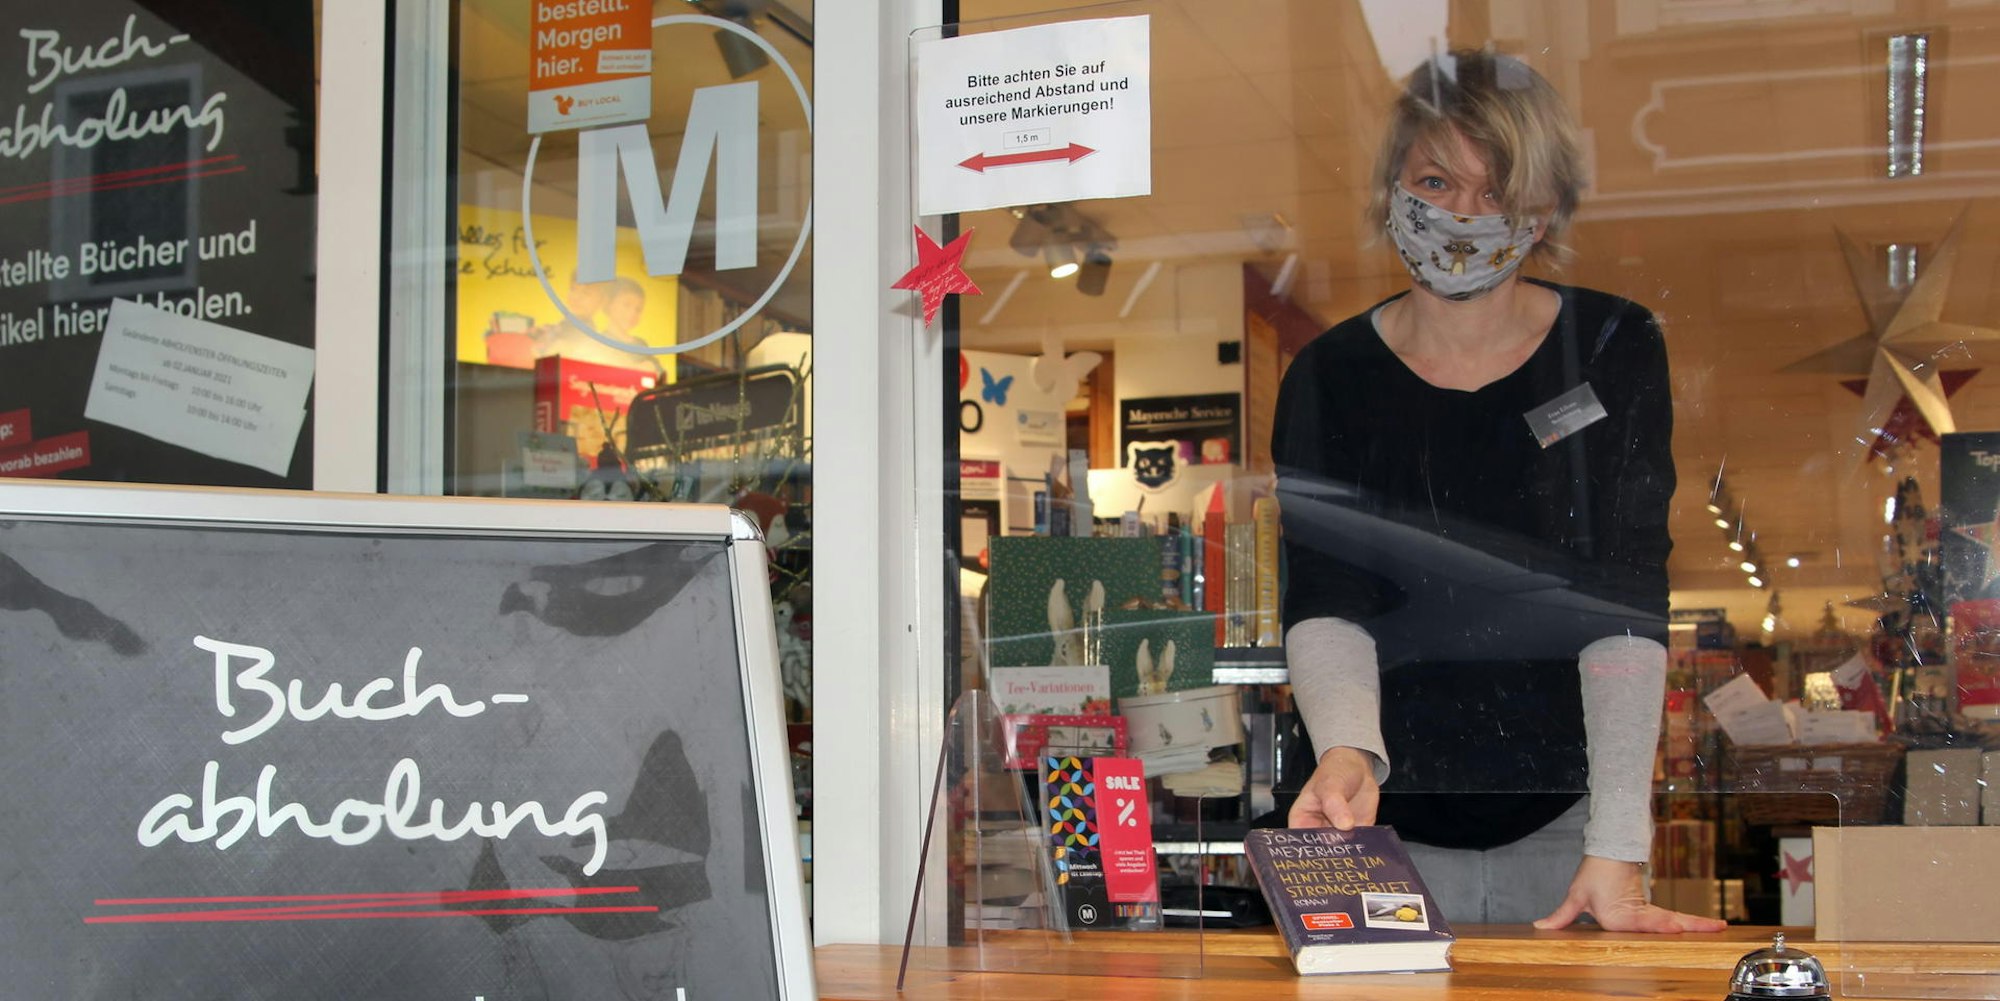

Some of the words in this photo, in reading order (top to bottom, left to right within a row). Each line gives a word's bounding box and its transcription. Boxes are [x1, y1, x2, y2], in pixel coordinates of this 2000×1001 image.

[538, 24, 622, 50] Morgen
[20, 14, 190, 94] Buch-
[537, 56, 583, 78] hier.
[967, 73, 1000, 88] Bitte
[1004, 68, 1051, 84] achten
[1055, 64, 1077, 77] Sie
[1081, 60, 1106, 74] auf
[578, 99, 593, 107] BUY
[595, 96, 622, 105] LOCAL
[945, 87, 1031, 108] ausreichend
[1035, 80, 1095, 98] Abstand
[1100, 77, 1129, 91] und
[959, 110, 1007, 126] unsere
[1011, 97, 1114, 120] Markierungen!
[1016, 133, 1029, 144] 1,5
[1030, 134, 1039, 142] m
[577, 80, 759, 284] M
[0, 249, 69, 288] tellte
[80, 235, 189, 275] Bücher
[199, 219, 257, 260] und
[0, 307, 44, 348] ikel
[54, 301, 108, 338] hier
[1128, 407, 1188, 425] Mayersche
[1190, 405, 1233, 419] Service
[33, 446, 83, 467] bezahlen
[193, 634, 530, 745] Buch-
[1005, 681, 1095, 695] Tee-Variationen
[1105, 775, 1141, 791] SALE
[137, 757, 609, 877] abholung
[1263, 832, 1345, 847] JOACHIM
[1268, 843, 1366, 859] MEYERHOFF
[1272, 856, 1355, 872] HAMSTER
[1362, 856, 1386, 868] IM
[1279, 871, 1371, 887] HINTEREN
[1285, 881, 1412, 899] STROMGEBIET
[1293, 897, 1329, 908] ROMAN
[1081, 908, 1094, 919] M
